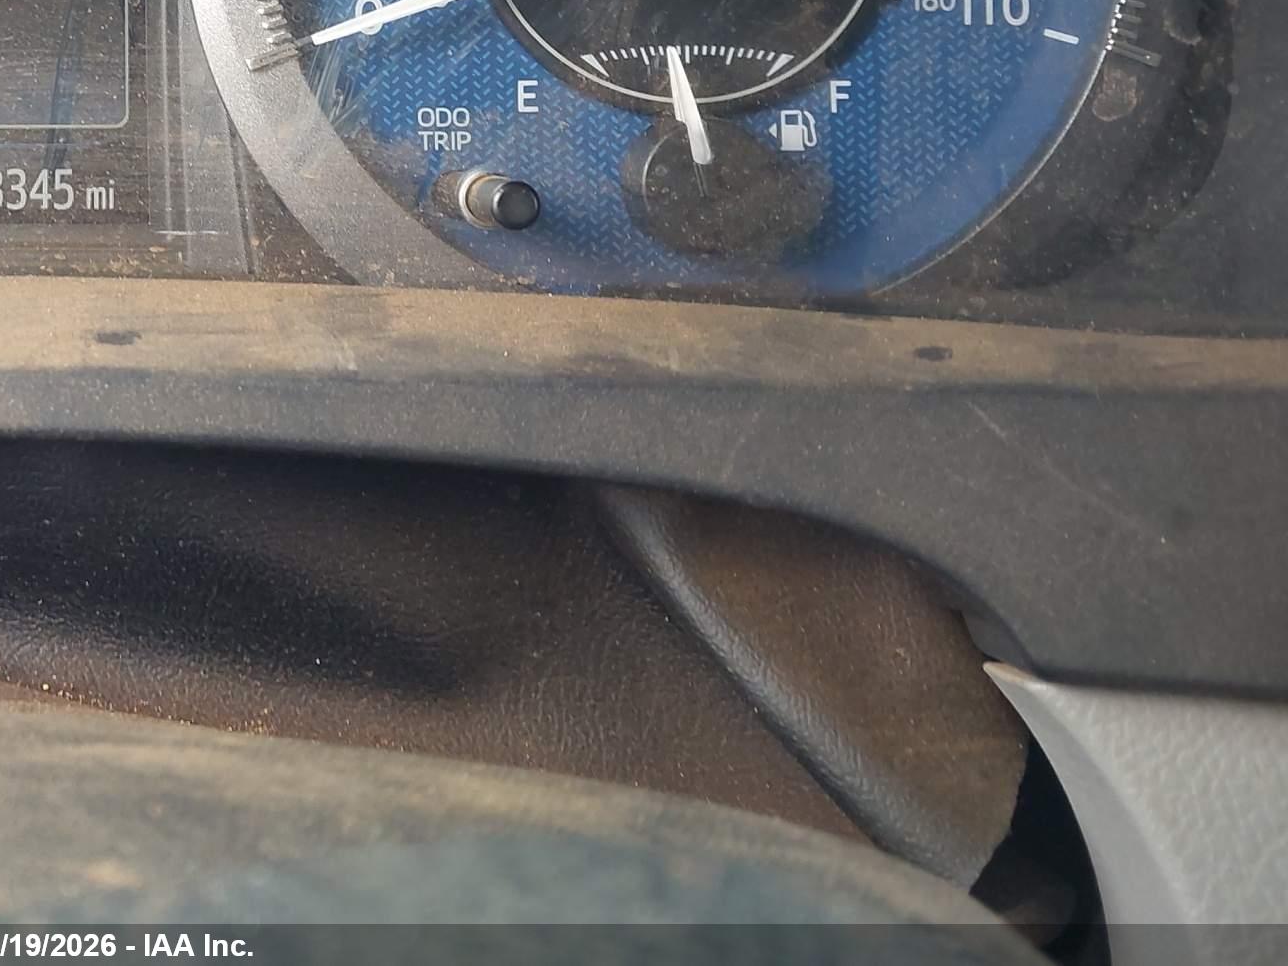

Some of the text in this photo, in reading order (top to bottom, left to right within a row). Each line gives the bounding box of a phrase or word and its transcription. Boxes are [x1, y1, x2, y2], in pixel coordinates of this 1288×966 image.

[517, 80, 540, 114] E
[829, 80, 853, 114] F
[417, 108, 471, 127] ODO
[418, 131, 472, 151] TRIP
[86, 180, 115, 210] mi
